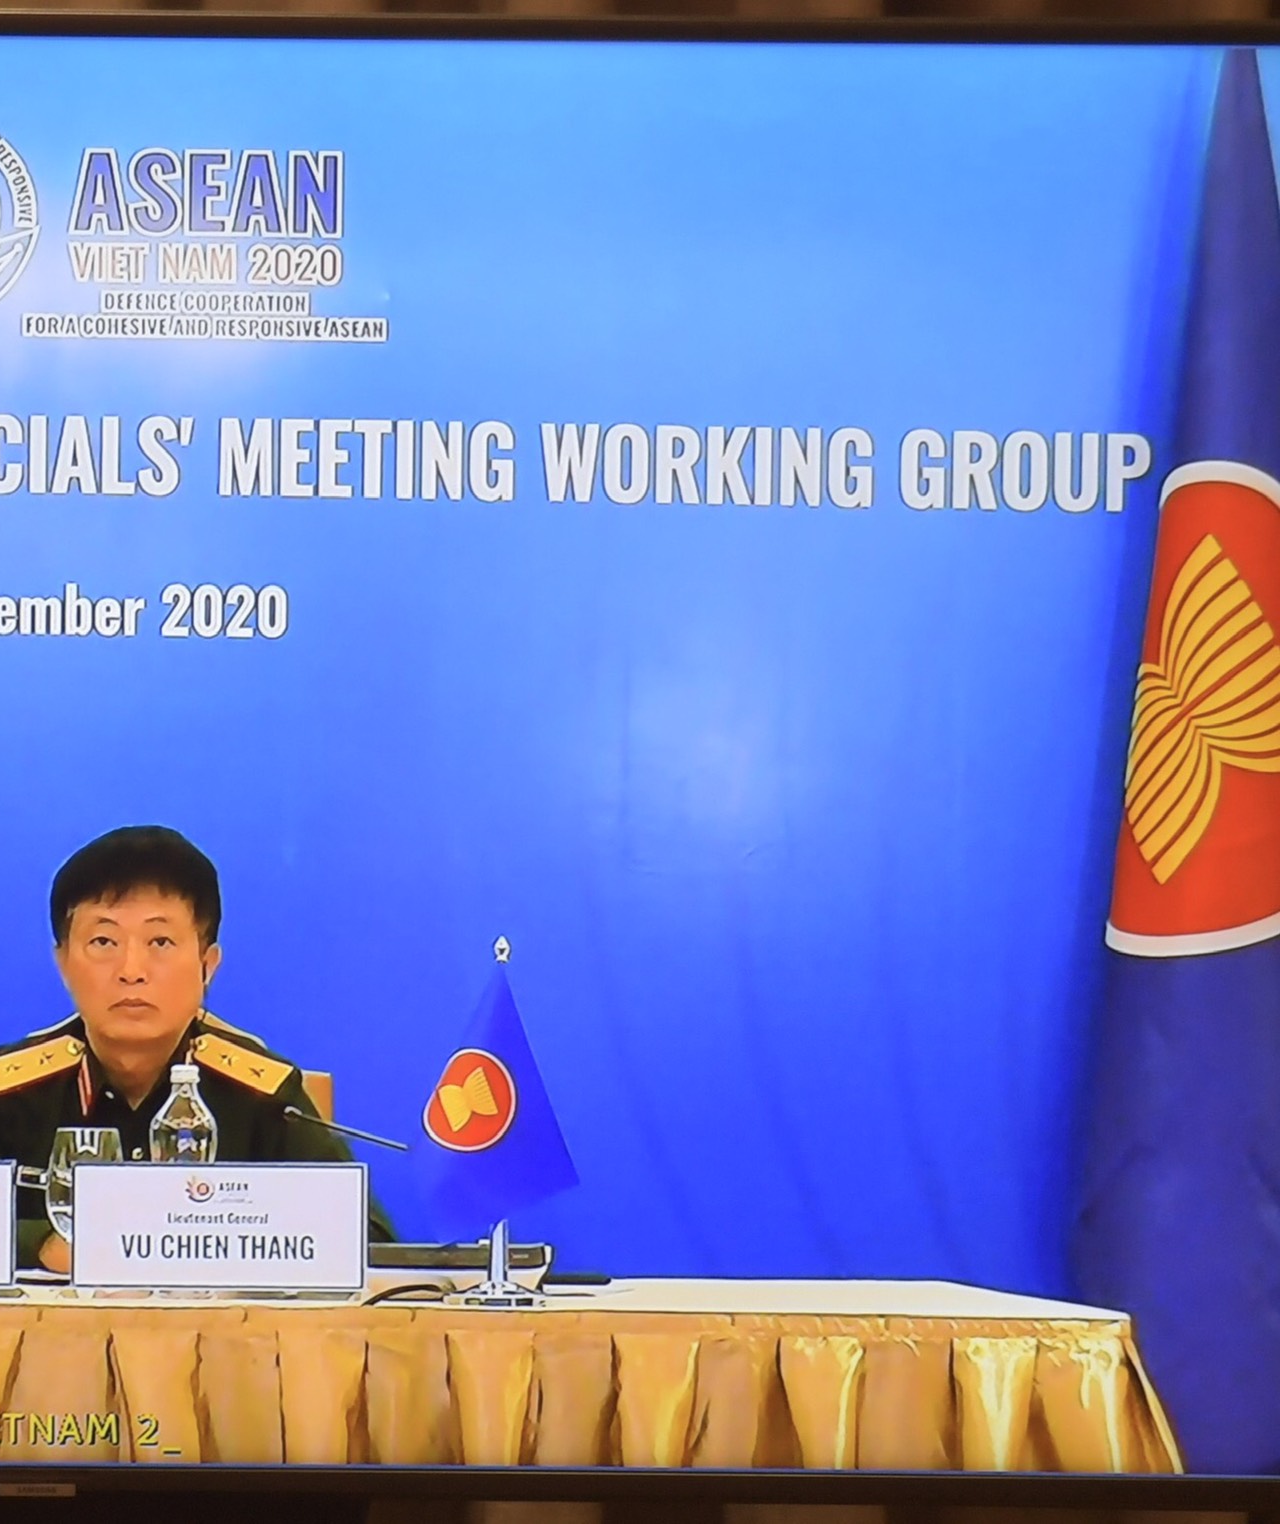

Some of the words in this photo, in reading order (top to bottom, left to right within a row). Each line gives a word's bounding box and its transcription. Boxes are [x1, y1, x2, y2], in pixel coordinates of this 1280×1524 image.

[70, 147, 343, 239] ASEAN
[69, 242, 149, 284] VIET
[158, 243, 237, 285] NAM
[247, 244, 342, 286] 2020
[104, 292, 177, 311] DEFENCE
[184, 293, 307, 313] COOPERATION
[25, 315, 60, 335] FOR
[65, 316, 77, 335] A
[83, 316, 169, 336] COHESIVE
[174, 317, 209, 337] AND
[216, 318, 322, 338] RESPONSIVE
[328, 319, 384, 339] ASEAN
[217, 416, 514, 502] MEETING
[541, 422, 874, 508] WORKING
[899, 430, 1151, 512] GROUP
[161, 583, 289, 638] 2020
[121, 1234, 151, 1259] VU
[161, 1234, 228, 1259] CHIEN
[238, 1235, 315, 1260] THANG
